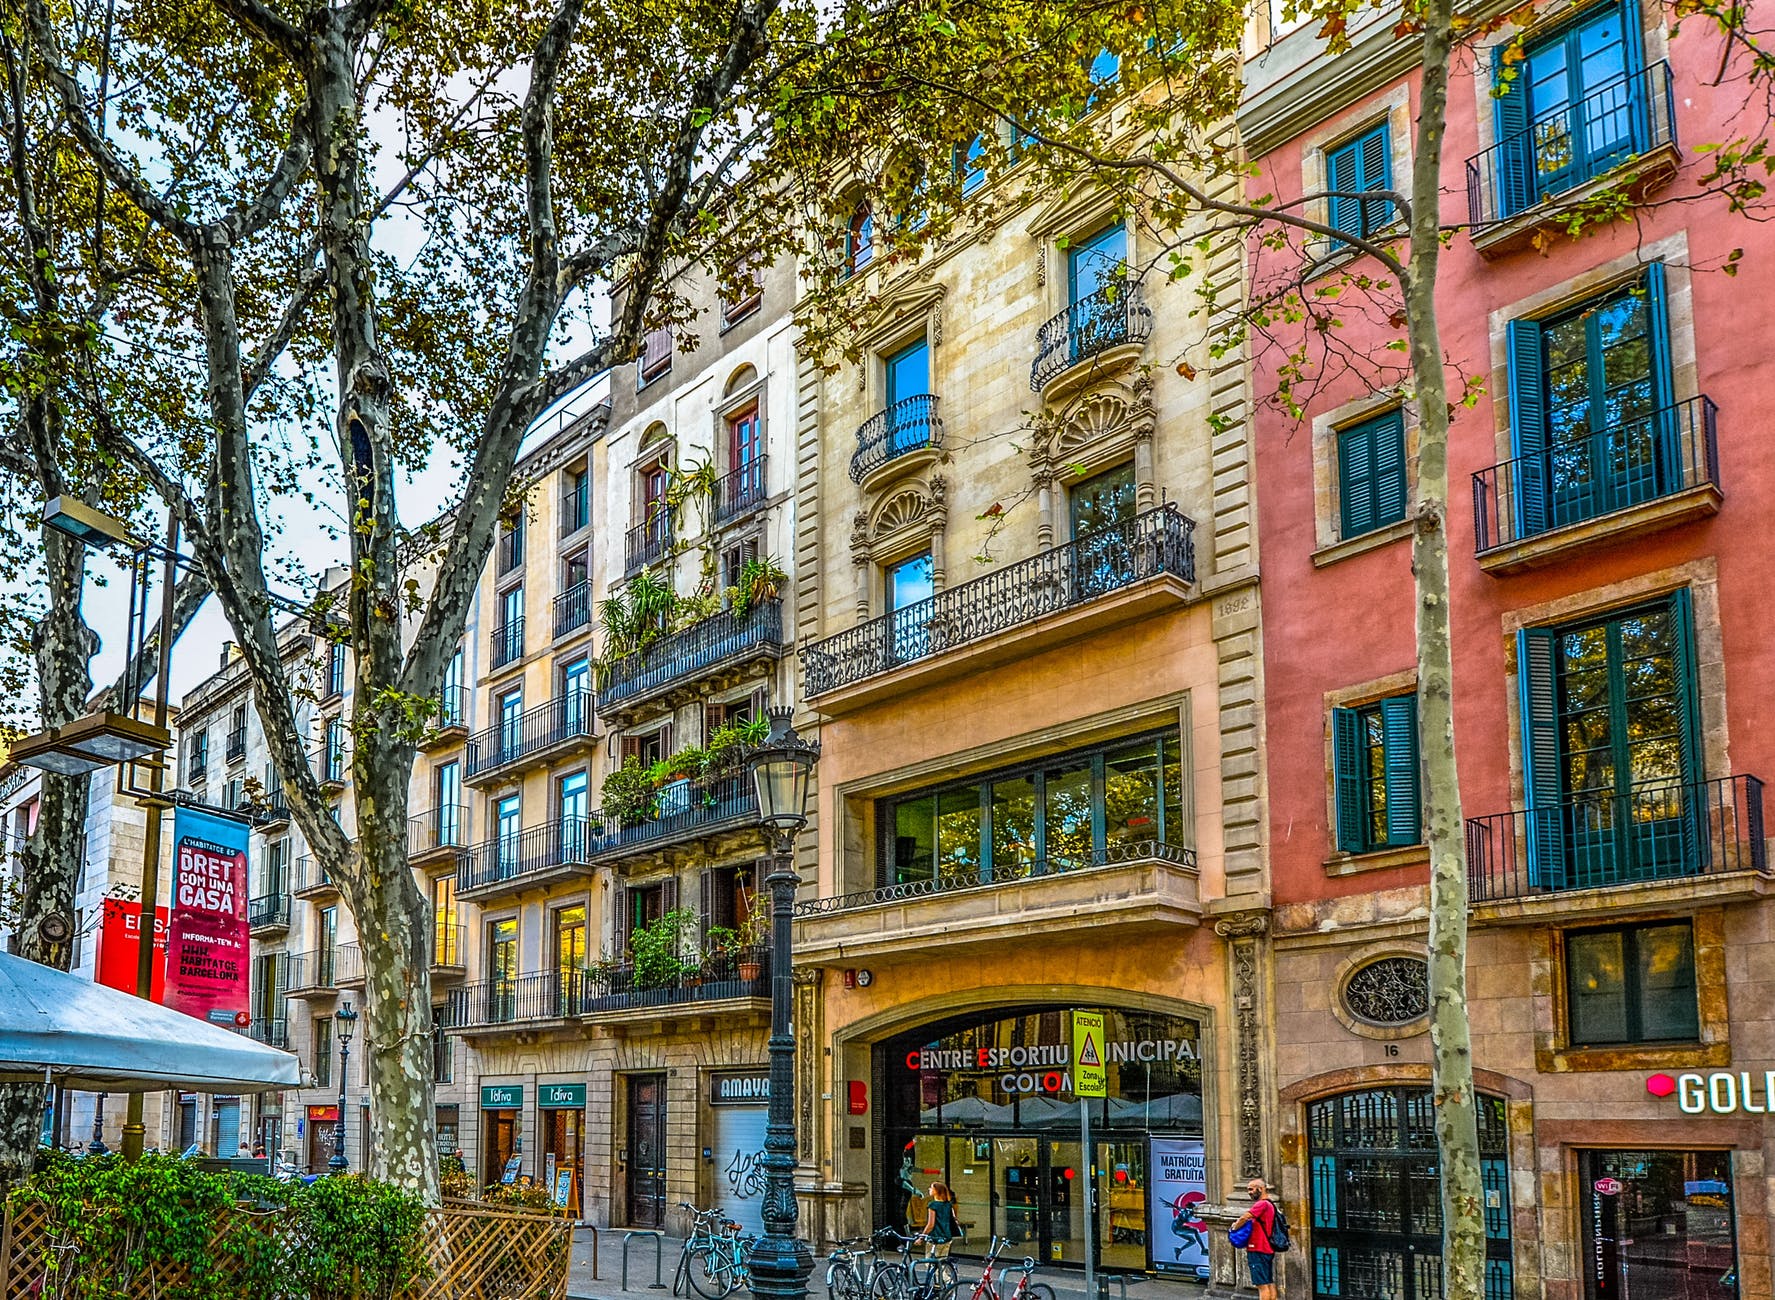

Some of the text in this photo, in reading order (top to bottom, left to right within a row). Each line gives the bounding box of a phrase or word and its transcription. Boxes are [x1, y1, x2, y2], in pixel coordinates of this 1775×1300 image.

[181, 847, 192, 855] UN
[180, 853, 234, 881] DRET
[180, 872, 234, 895] COM UNA
[179, 884, 234, 915] CASA
[180, 966, 239, 982] BARCELONA
[1076, 1016, 1102, 1028] ATENCIÓ
[906, 1050, 972, 1070] CENTRE
[978, 1045, 1068, 1067] ESPORTIU
[1384, 1044, 1399, 1057] 16
[1083, 1070, 1098, 1080] Zona
[721, 1078, 770, 1097] AMAYA
[1164, 1168, 1205, 1181] GRATUÏTA
